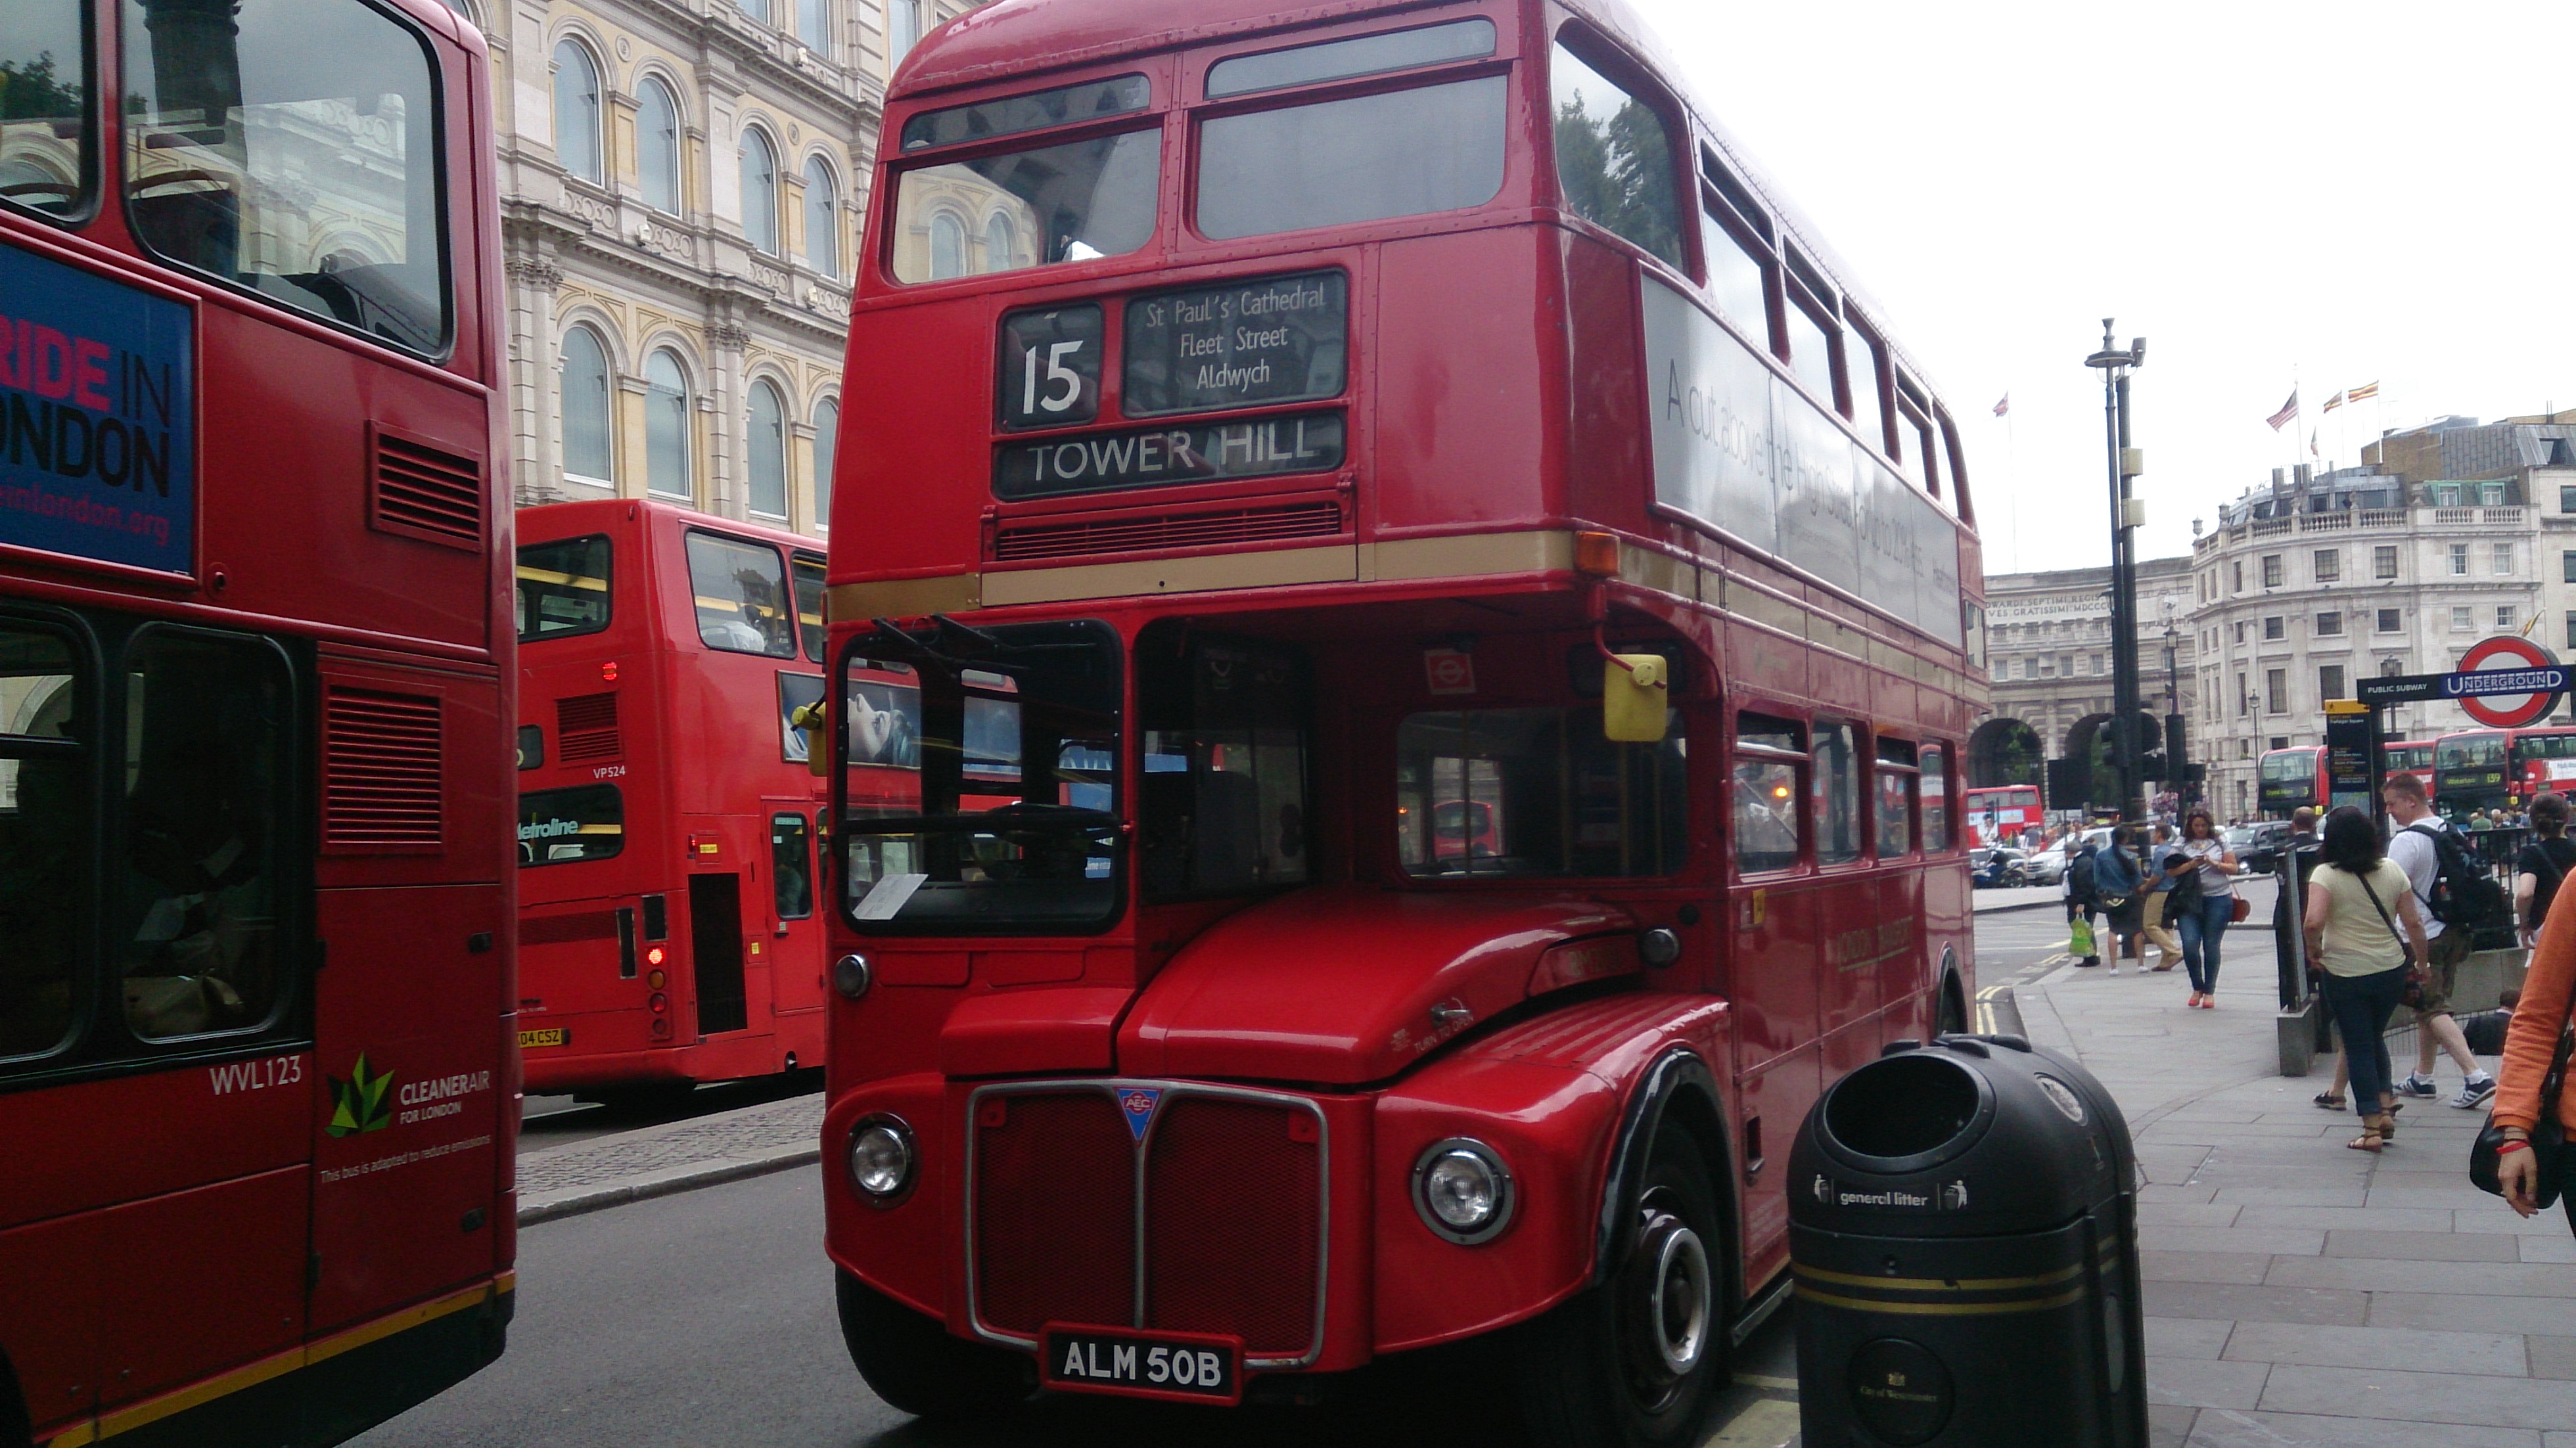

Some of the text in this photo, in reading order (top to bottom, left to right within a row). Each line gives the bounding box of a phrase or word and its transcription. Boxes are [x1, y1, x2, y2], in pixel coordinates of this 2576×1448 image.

[1147, 282, 1325, 328] St Paul's Cathedral
[1180, 326, 1288, 358] Fleet Street
[120, 350, 170, 428] IN
[1022, 340, 1084, 415] 15
[1196, 358, 1270, 393] Aldwych
[1667, 358, 1685, 428] A
[1690, 384, 1718, 447] cut
[1720, 396, 1764, 478] above
[0, 392, 170, 497] NDON
[1027, 419, 1318, 481] TOWER HILL
[2013, 606, 2069, 616] GRATISSIMI
[2027, 597, 2067, 607] SEPTIMI
[2368, 683, 2427, 694] PUBLIC SUBWAY
[2447, 670, 2563, 694] UNDERGROUND
[593, 765, 626, 779] VP524
[2487, 773, 2501, 783] 139
[538, 1029, 559, 1043] CSZ
[209, 1054, 302, 1095] WVL123
[400, 1101, 462, 1125] FOR LONDON
[1126, 1099, 1150, 1108] AEC
[320, 1134, 491, 1183] This bus is adapted to reduce emissions
[1841, 1191, 1929, 1206] general litter
[1063, 1342, 1221, 1387] ALM 50B
